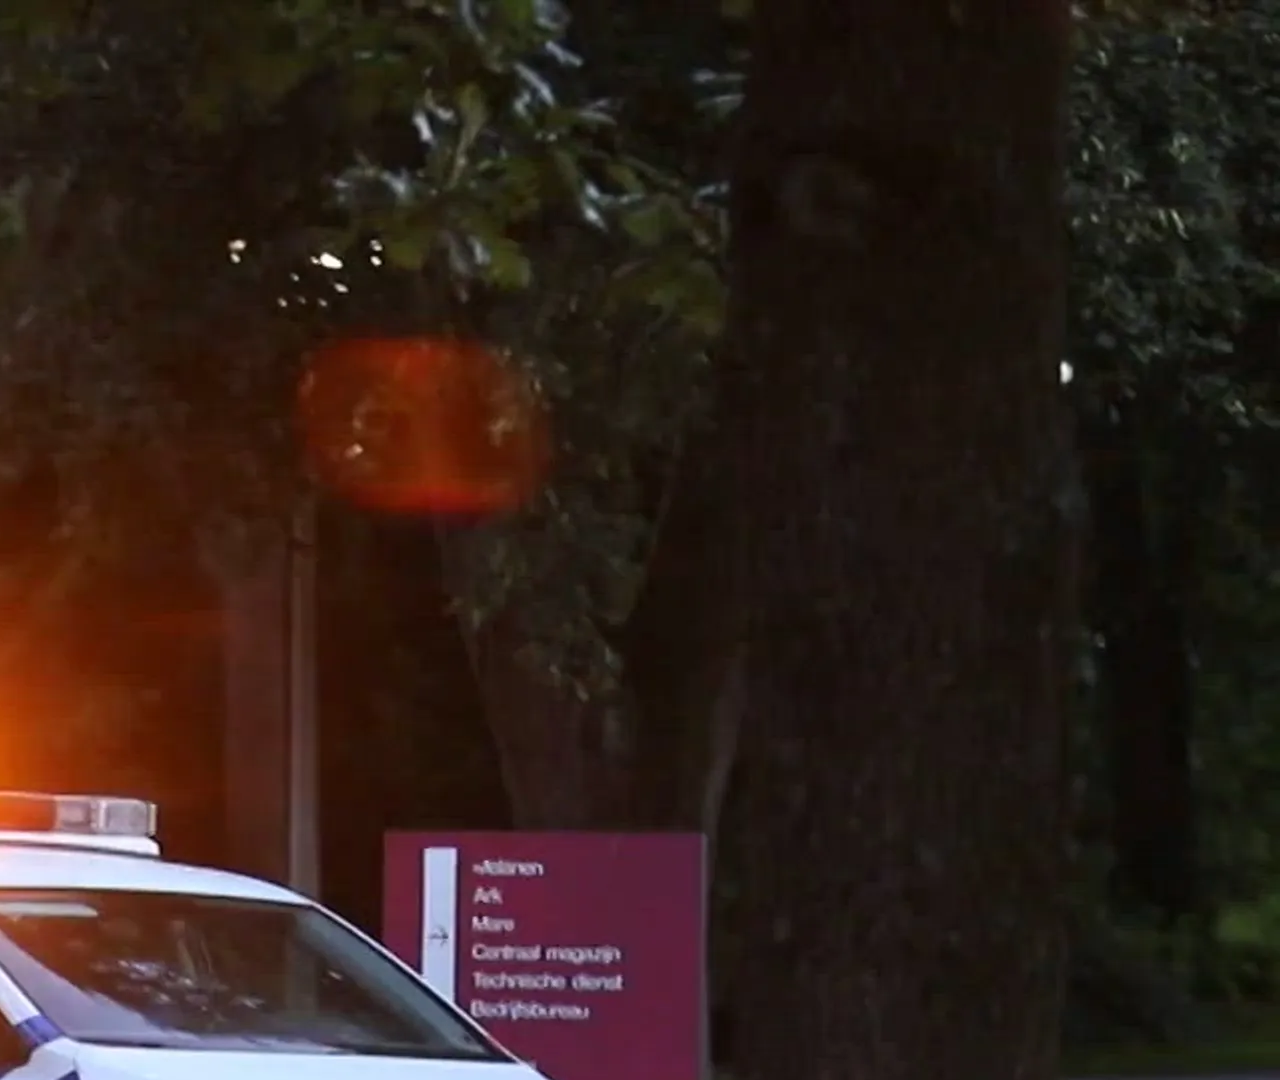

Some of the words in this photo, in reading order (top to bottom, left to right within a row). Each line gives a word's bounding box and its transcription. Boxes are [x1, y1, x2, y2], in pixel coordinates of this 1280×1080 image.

[472, 944, 541, 961] Centraal
[545, 946, 622, 965] magazijn
[473, 972, 567, 990] Technische
[571, 973, 624, 991] dienst
